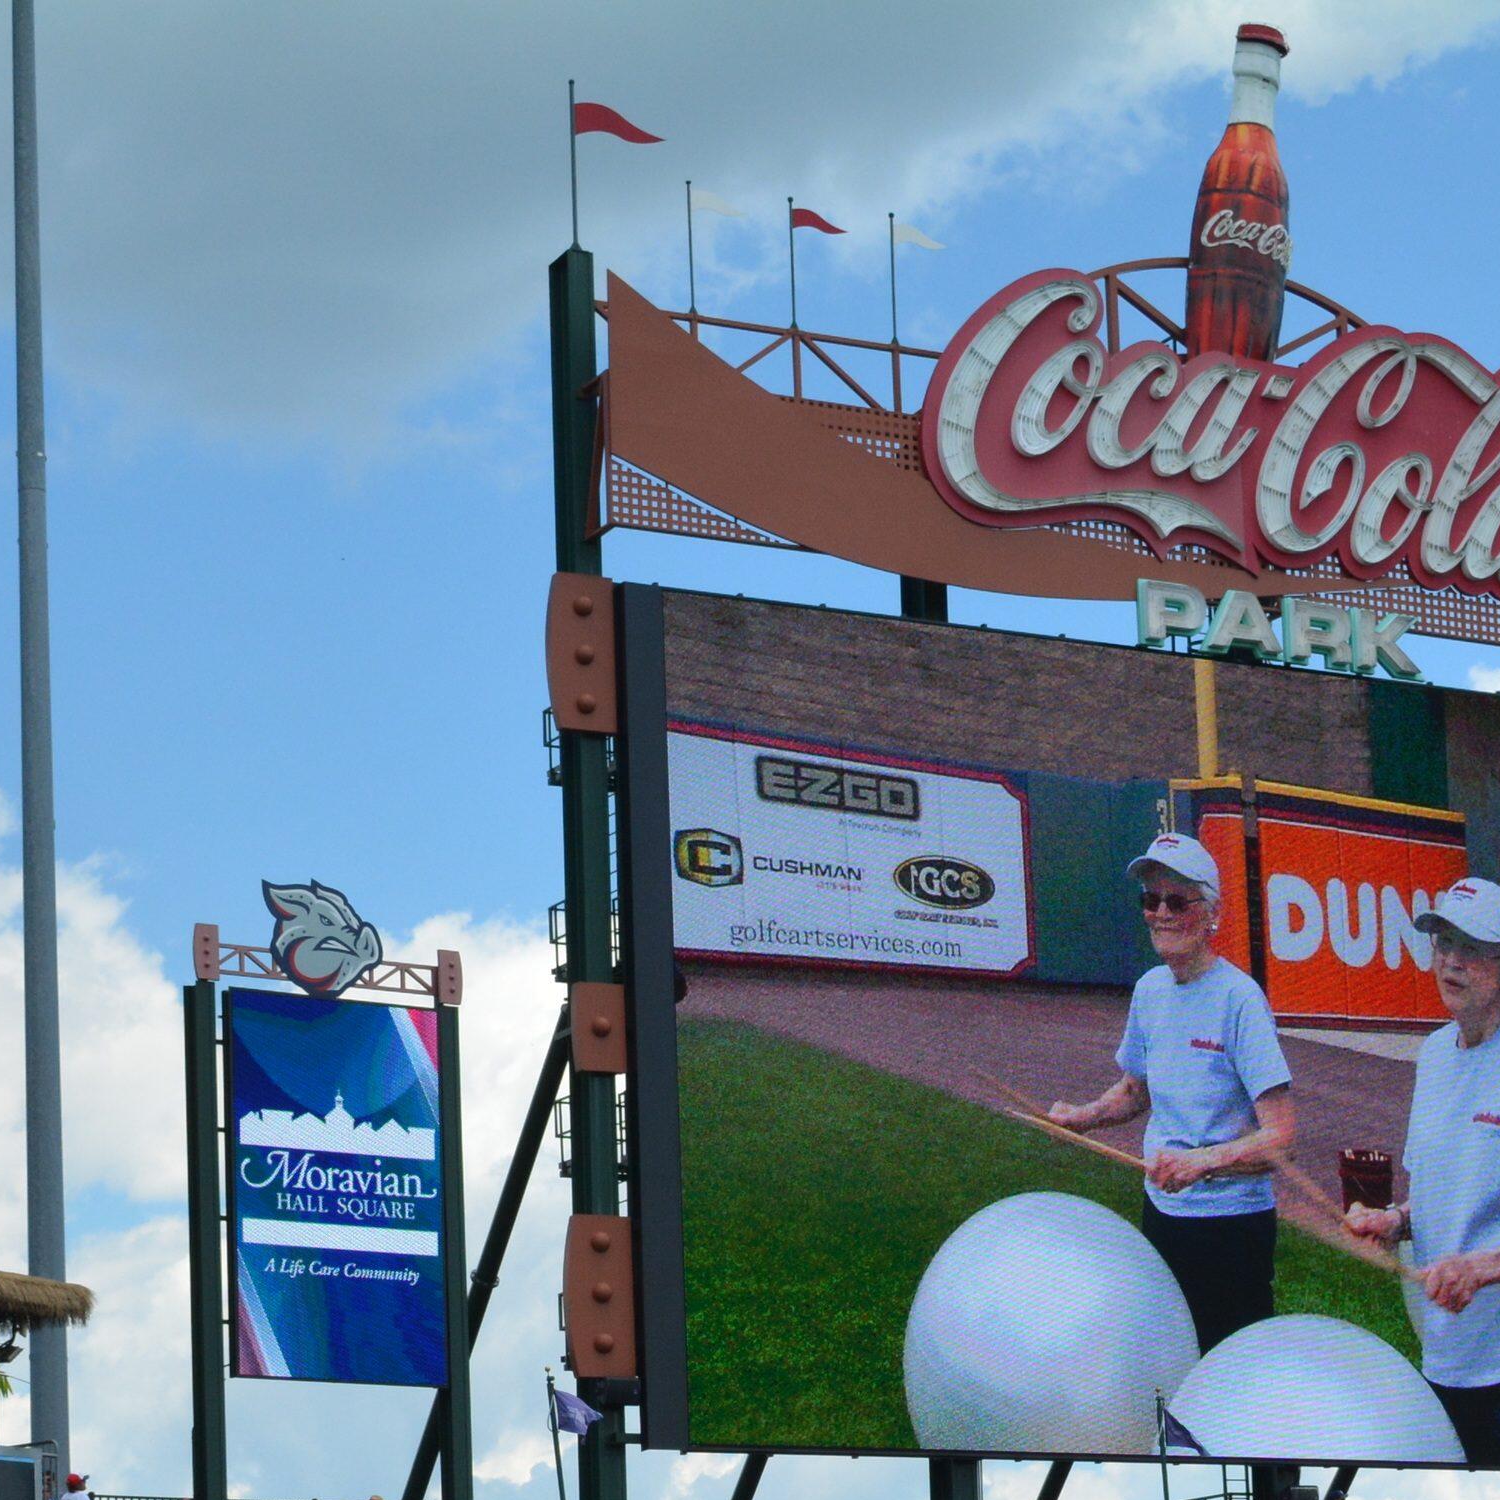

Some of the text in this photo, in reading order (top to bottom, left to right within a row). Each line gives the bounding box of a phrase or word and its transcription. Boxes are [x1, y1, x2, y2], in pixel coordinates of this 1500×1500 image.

[1137, 577, 1424, 681] PARK
[760, 761, 918, 818] EZGO
[753, 856, 863, 881] CUSHMAN
[729, 919, 963, 958] golfcartservices.com
[1267, 873, 1448, 973] DUN
[240, 1150, 438, 1199] Moravian
[276, 1193, 416, 1221] HALL SQUARE
[264, 1257, 420, 1287] A Life Care Community
